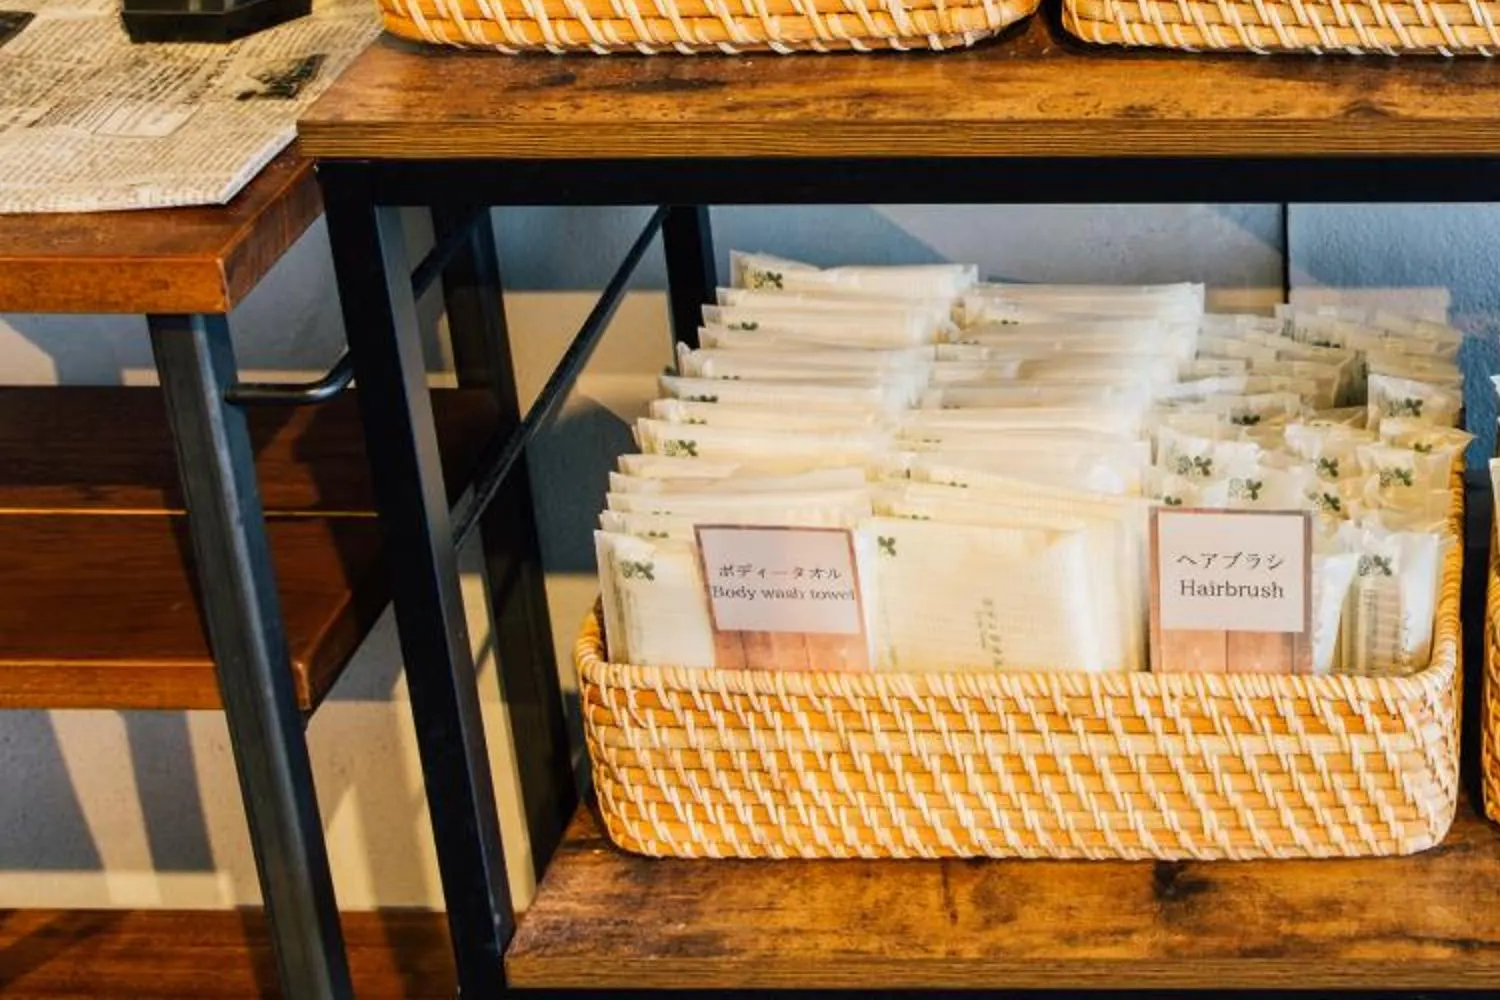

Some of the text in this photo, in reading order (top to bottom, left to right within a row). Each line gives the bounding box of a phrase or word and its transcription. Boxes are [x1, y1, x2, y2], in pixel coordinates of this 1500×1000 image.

[1176, 552, 1285, 571] ヘアブラシ
[719, 563, 841, 580] ボディータオル
[712, 585, 855, 601] Body wash towel
[1179, 579, 1285, 600] Hairbrush
